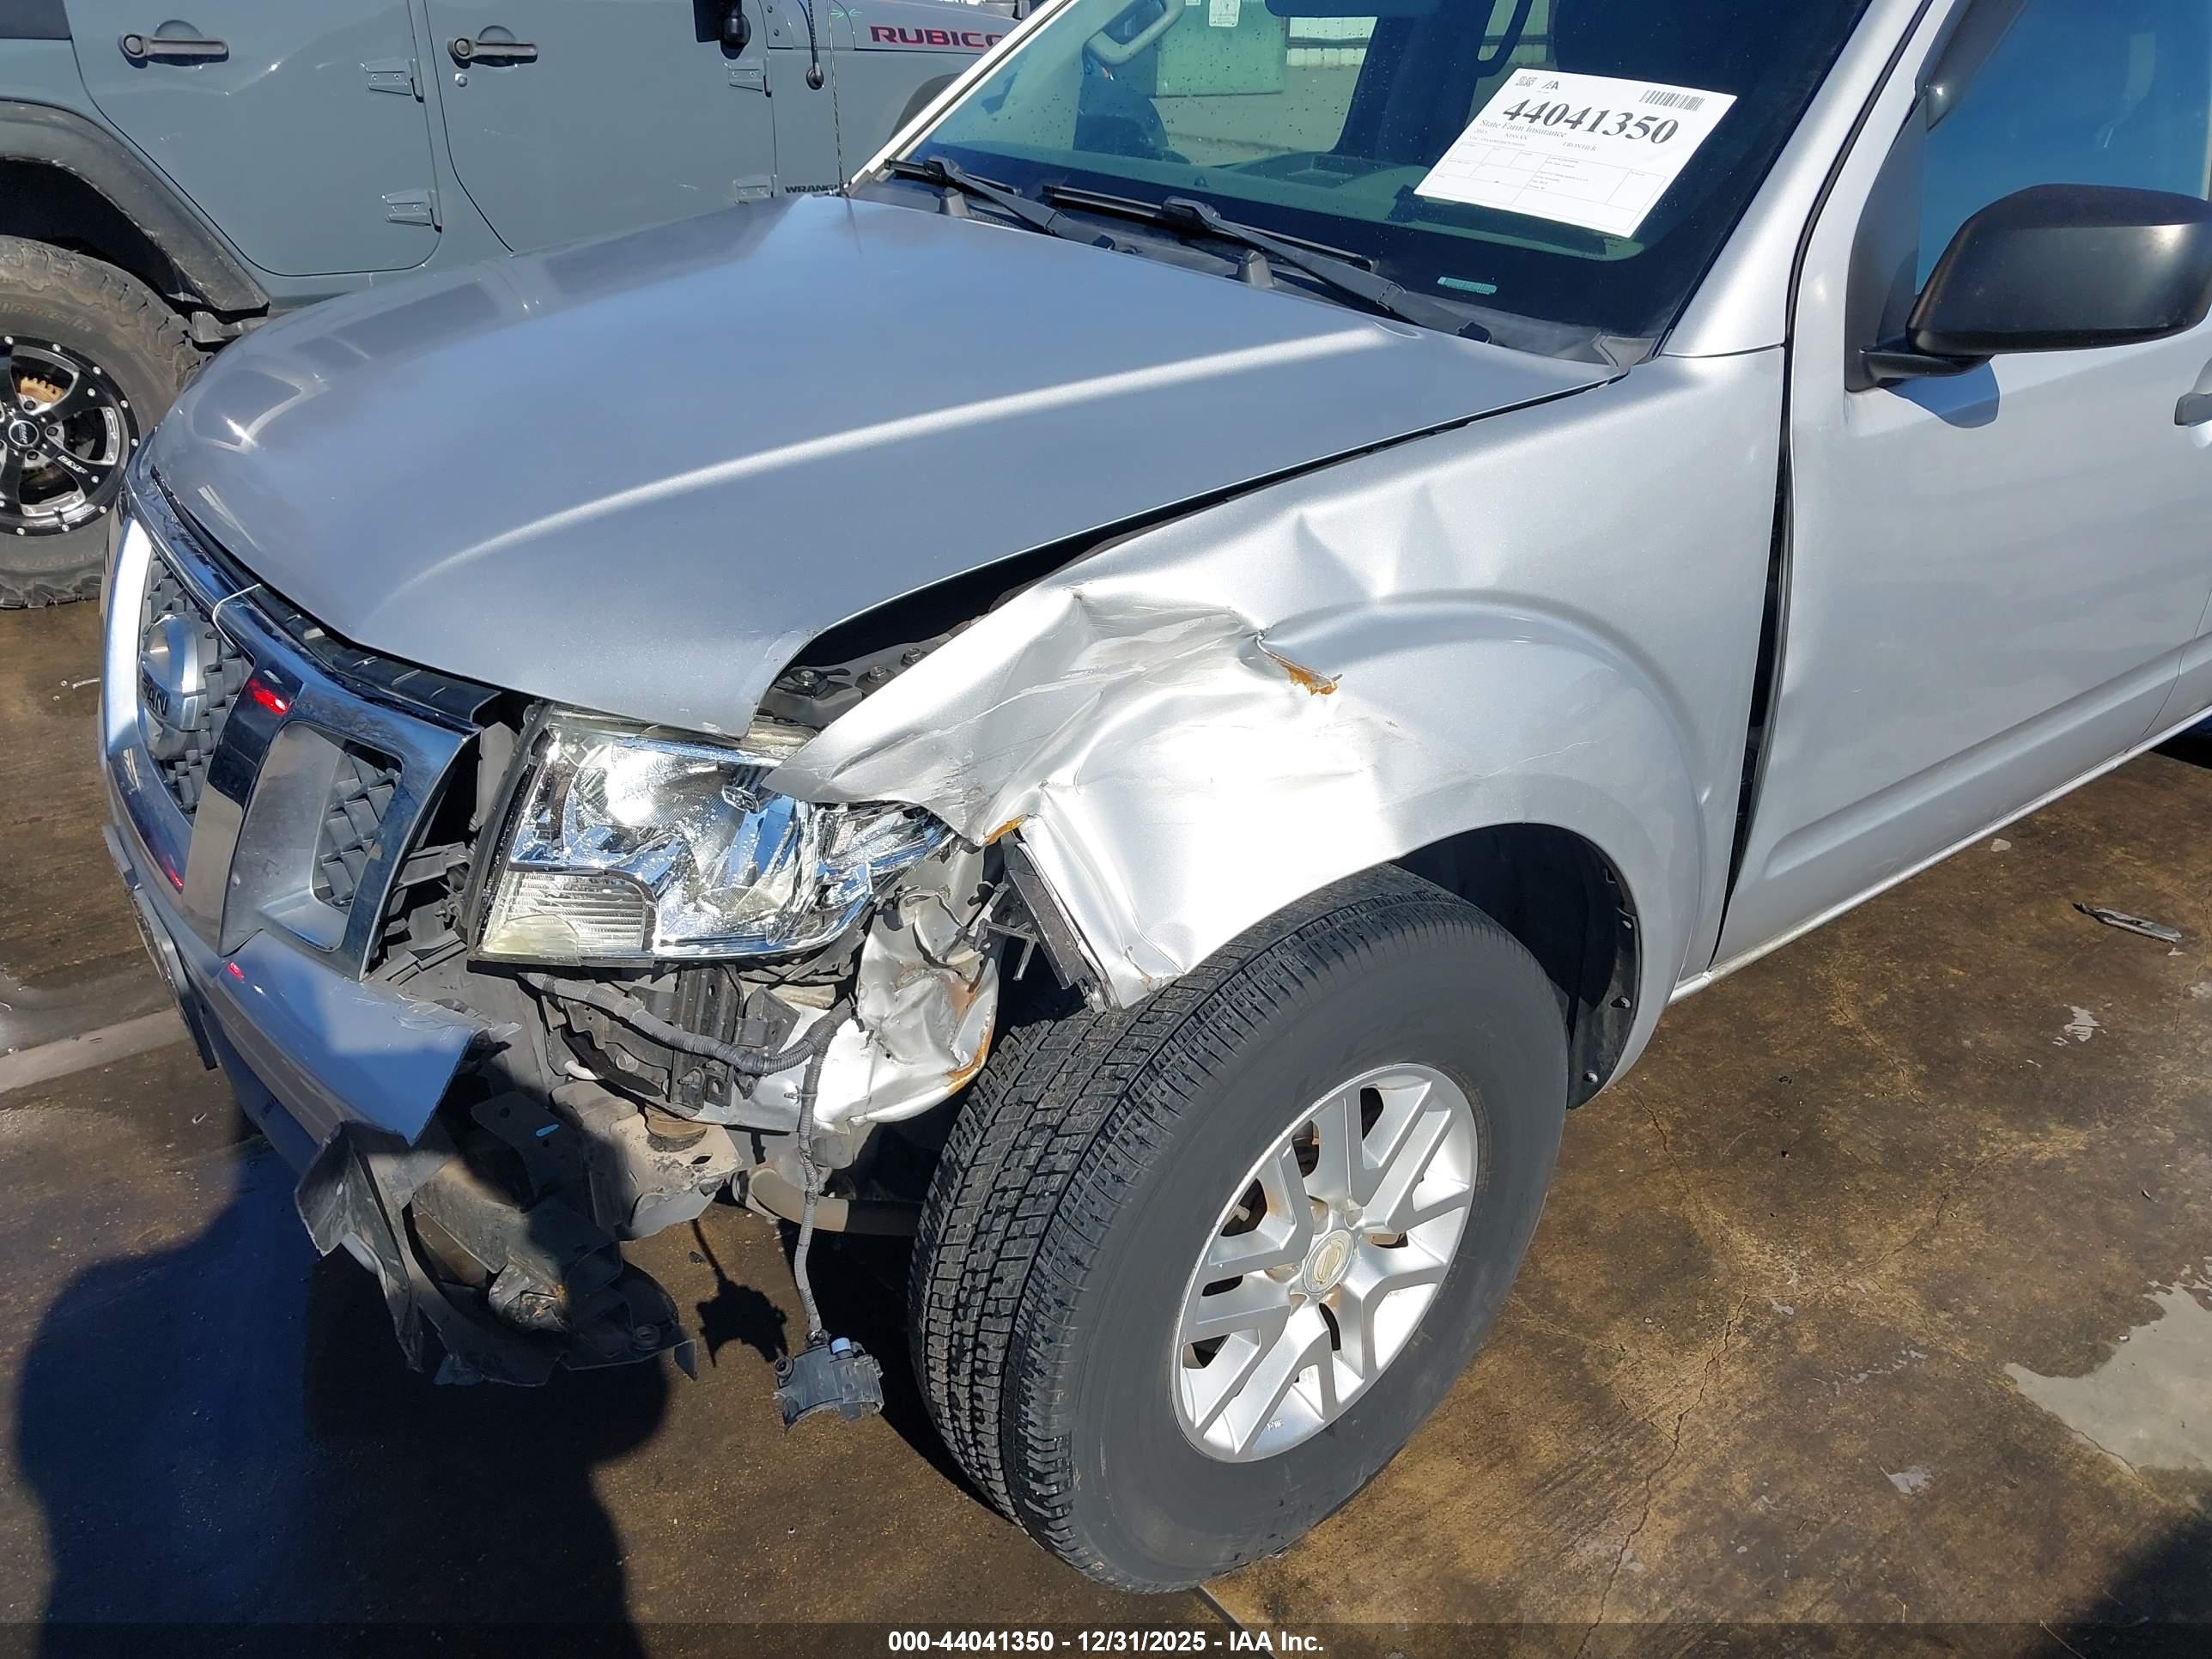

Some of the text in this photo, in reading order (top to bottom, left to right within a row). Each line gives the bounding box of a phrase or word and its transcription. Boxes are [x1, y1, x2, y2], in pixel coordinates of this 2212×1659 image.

[1479, 119, 1567, 138] State Farm Insurance
[1503, 99, 1679, 144] 44041350
[1562, 141, 1597, 152] FRONTIER
[785, 184, 839, 194] WRANG
